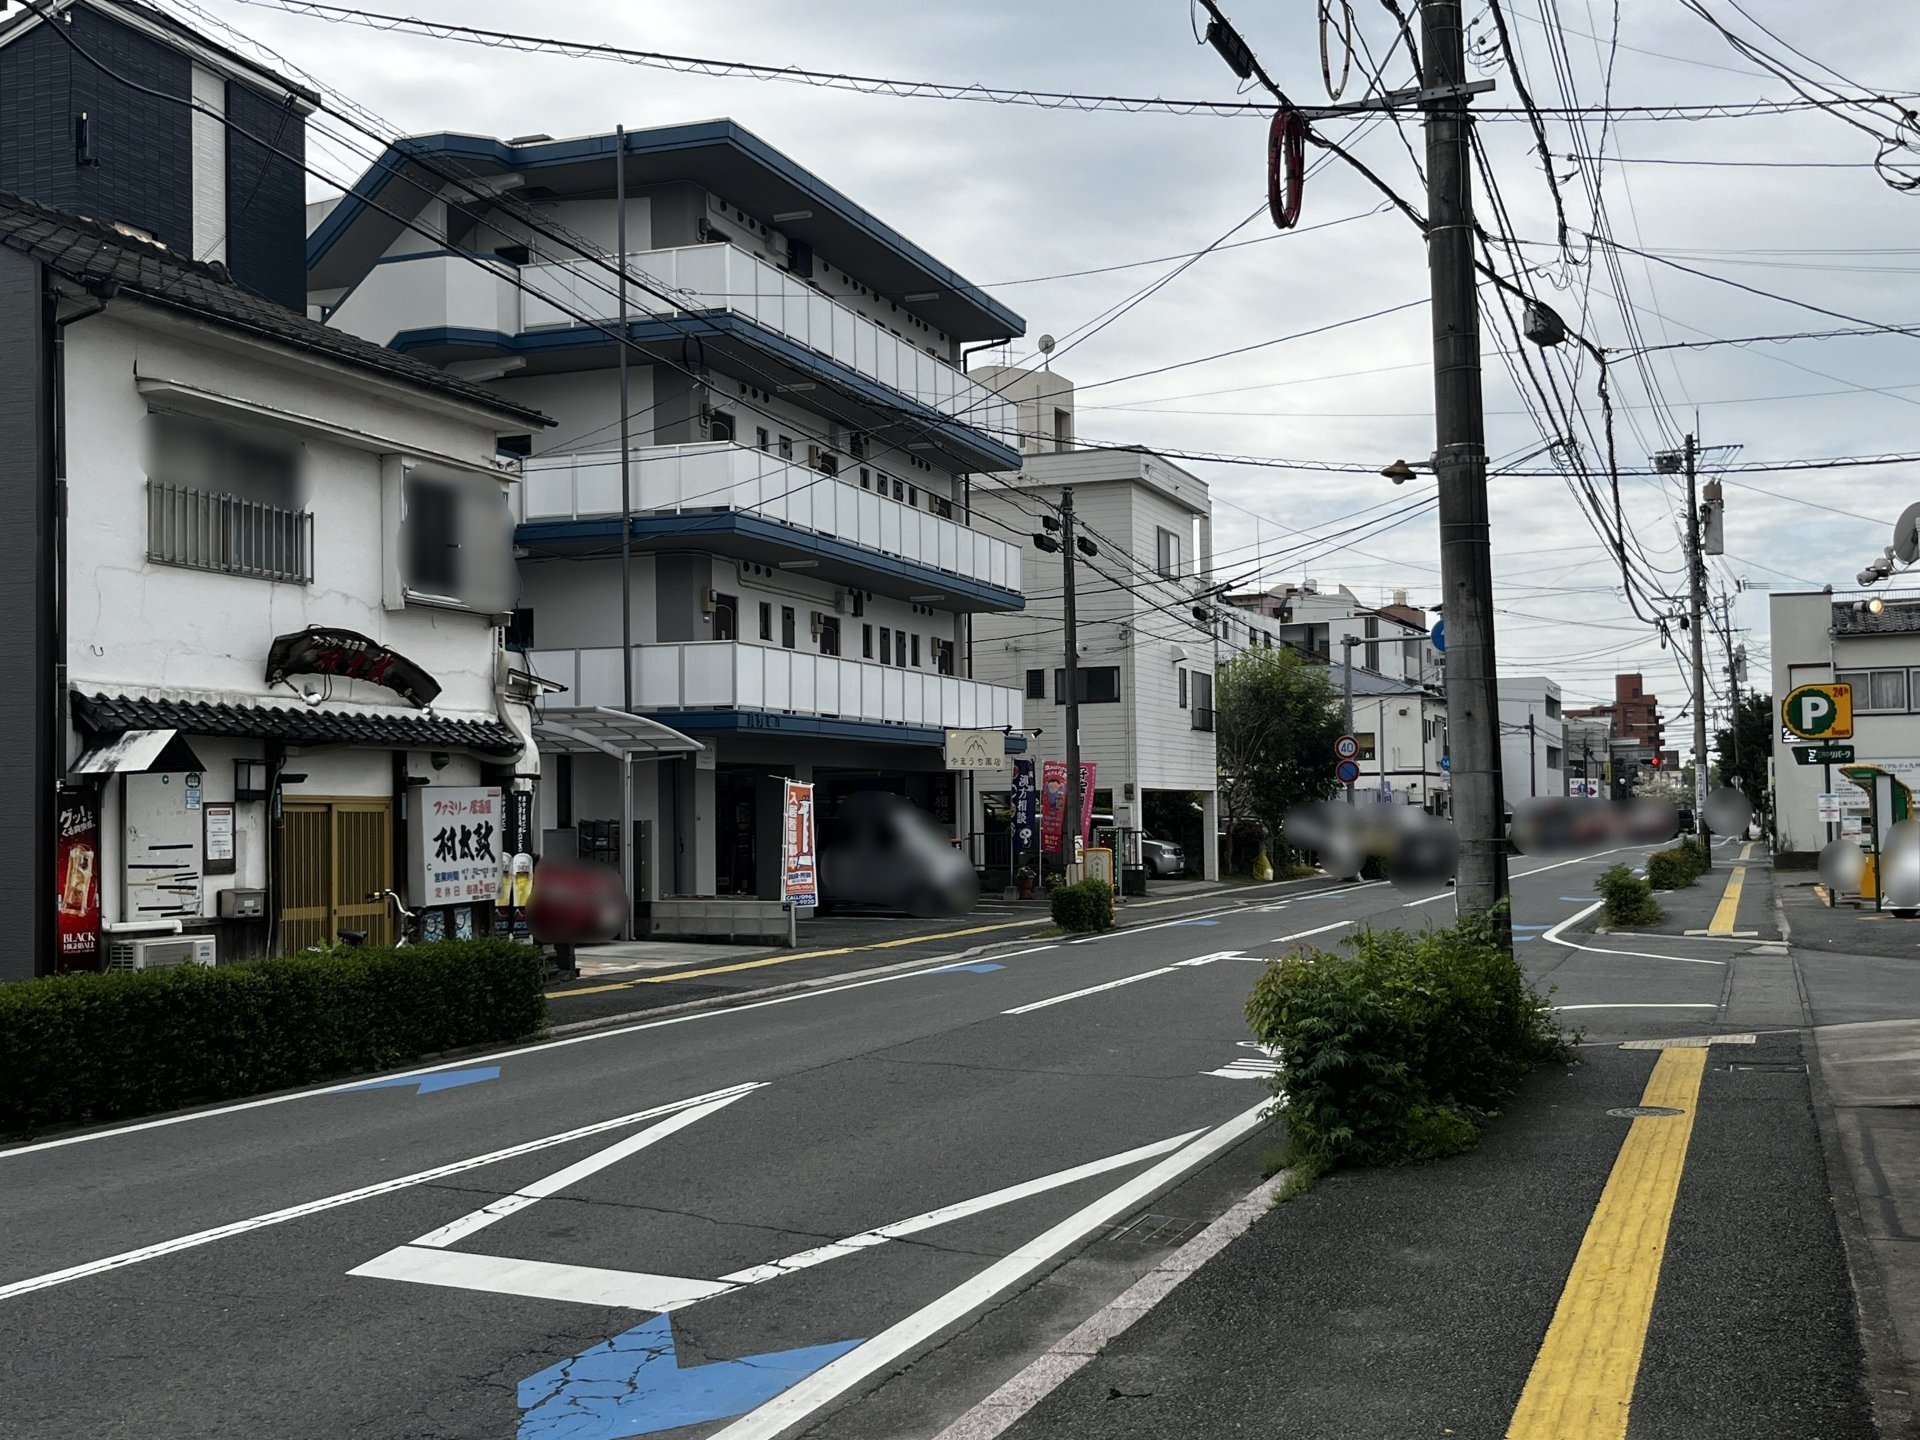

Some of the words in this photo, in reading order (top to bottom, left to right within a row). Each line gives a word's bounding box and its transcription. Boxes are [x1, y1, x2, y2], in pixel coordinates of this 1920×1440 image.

[1802, 697, 1828, 729] P
[1341, 743, 1353, 753] 40
[1016, 774, 1029, 824] 漢方相談
[63, 932, 95, 943] BLACK
